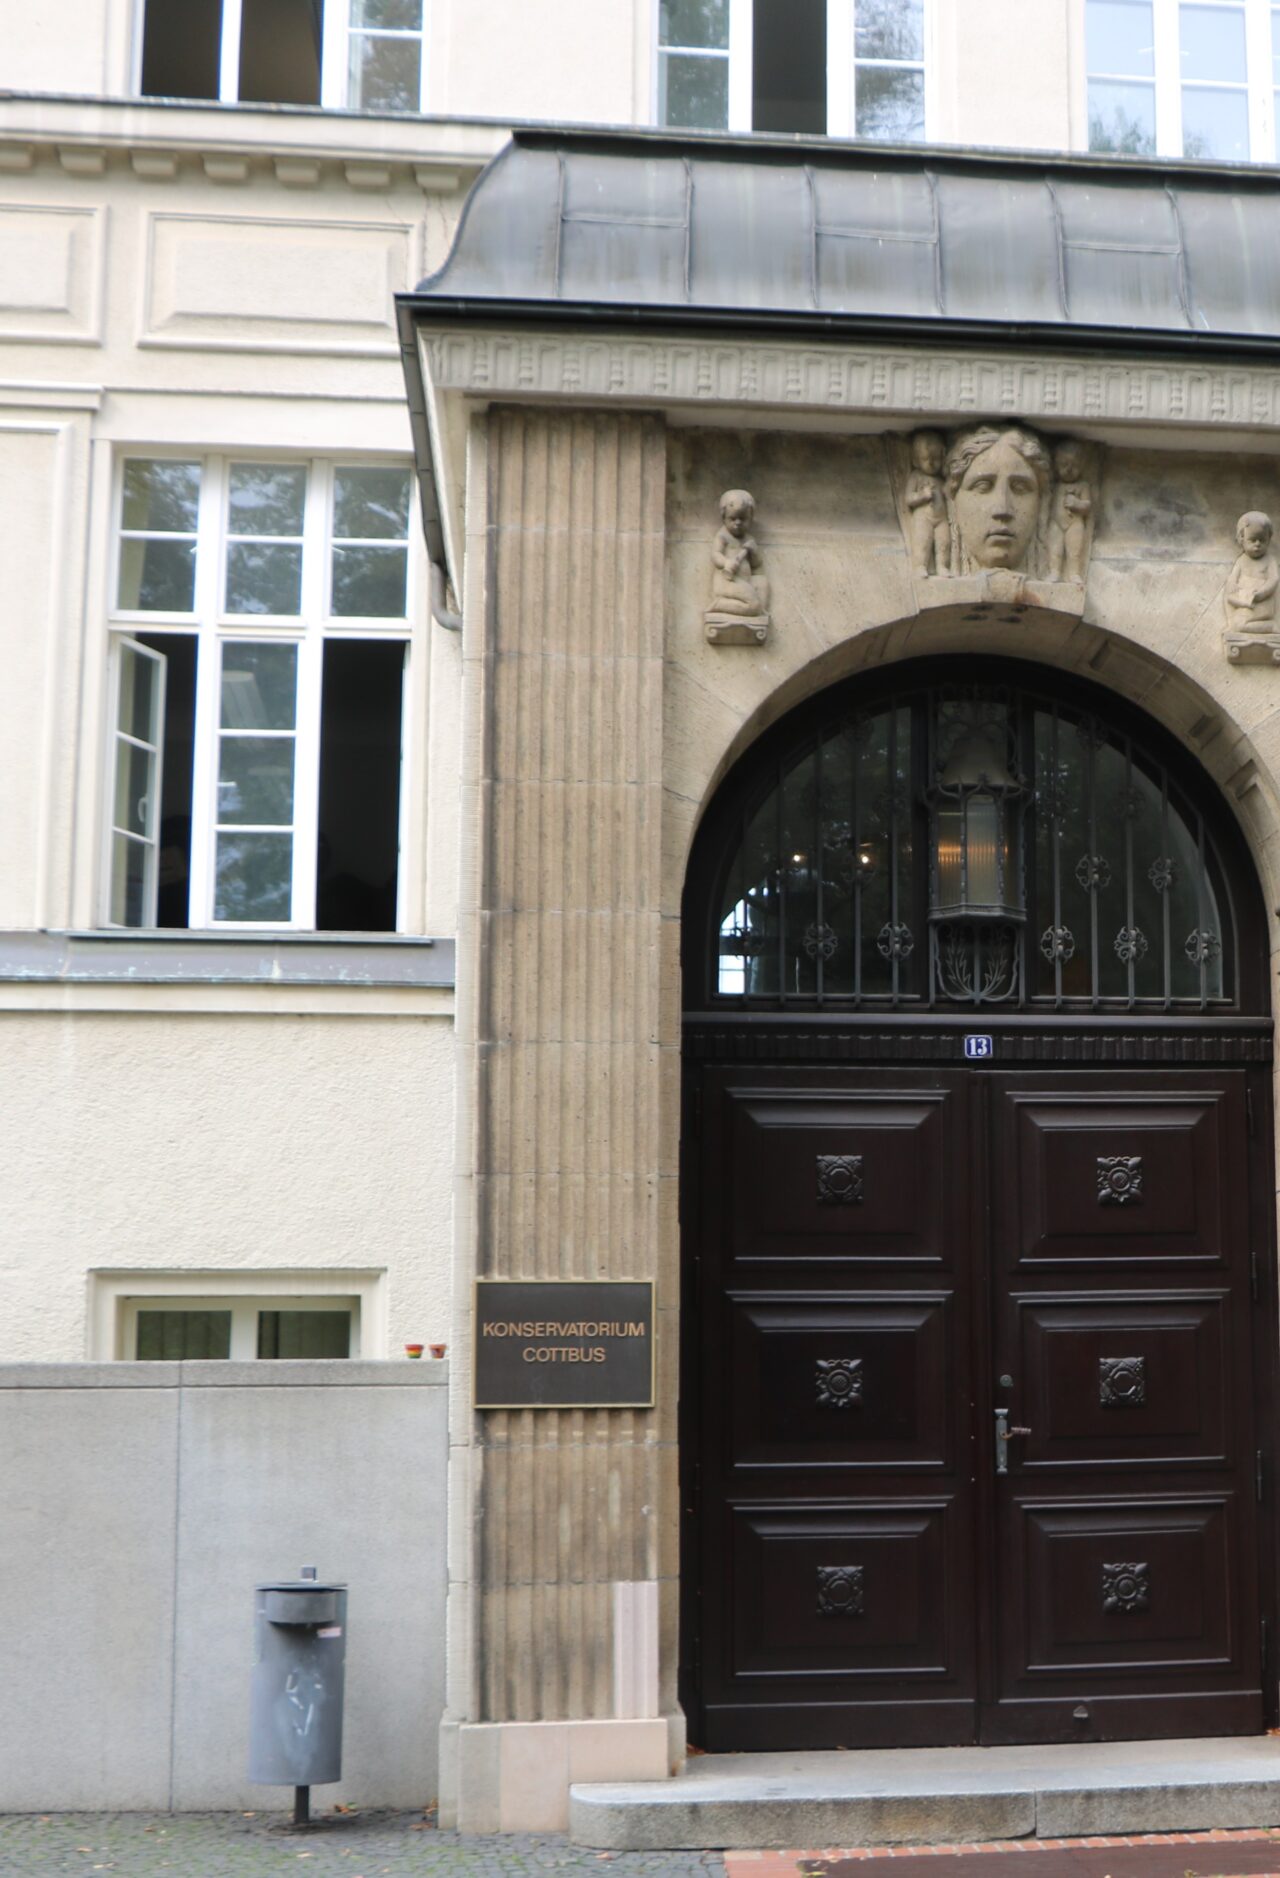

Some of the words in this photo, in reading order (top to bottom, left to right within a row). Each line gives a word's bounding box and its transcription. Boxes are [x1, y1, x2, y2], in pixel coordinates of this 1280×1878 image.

[970, 1038, 988, 1056] 13
[483, 1322, 645, 1337] KONSERVATORIUM
[523, 1347, 606, 1362] COTTBUS
